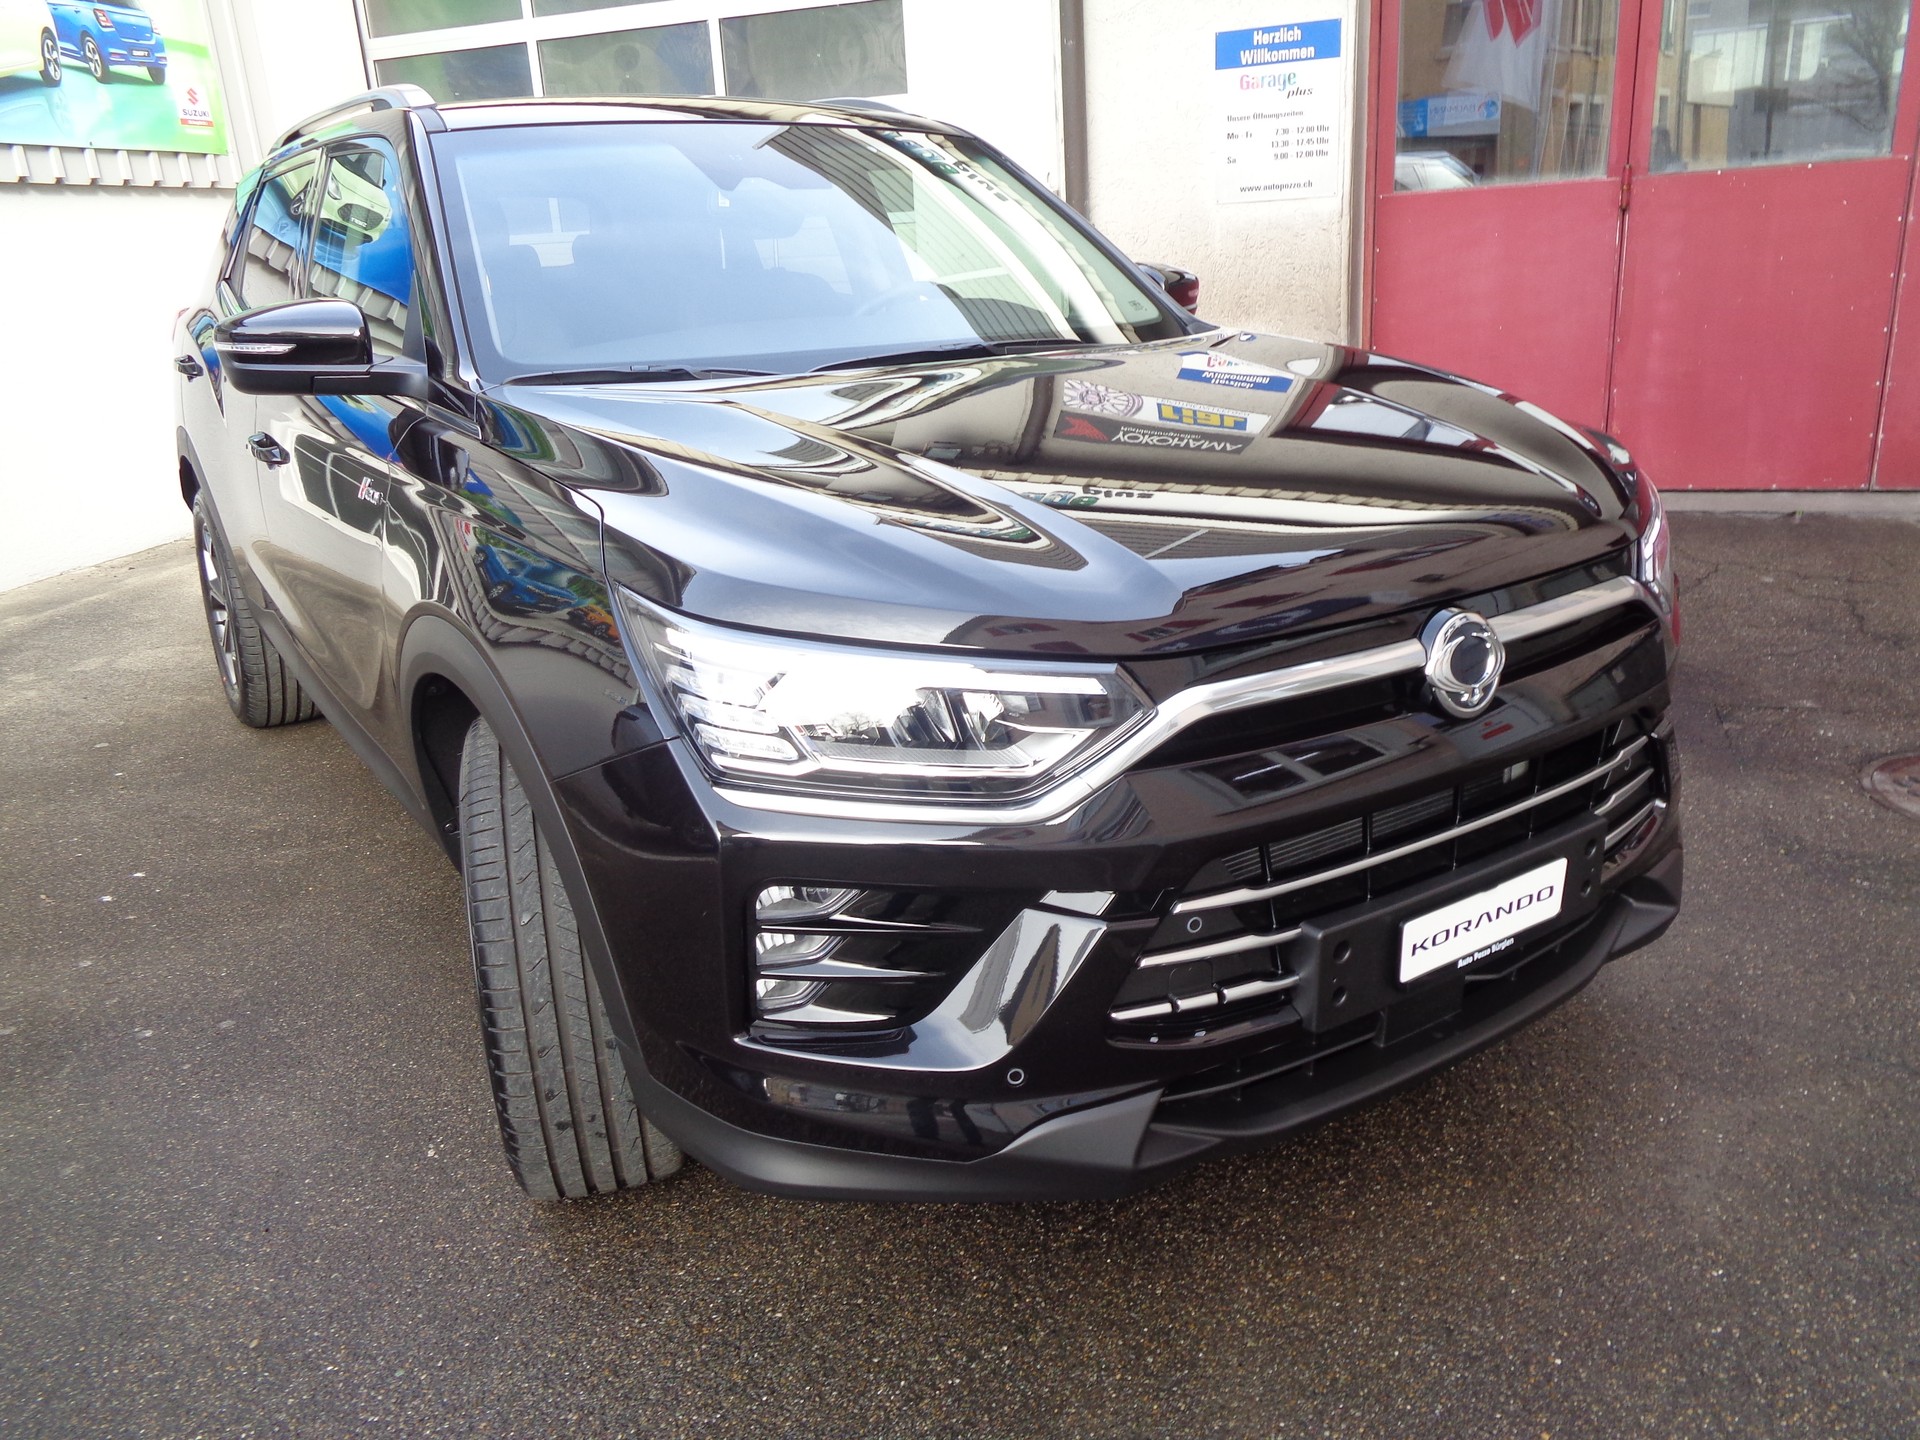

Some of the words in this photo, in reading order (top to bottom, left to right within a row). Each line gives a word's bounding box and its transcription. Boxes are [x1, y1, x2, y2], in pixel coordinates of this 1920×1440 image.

[1253, 26, 1302, 45] Herzlich
[1240, 46, 1315, 65] Willkommen
[1239, 72, 1297, 91] Garage
[1286, 87, 1313, 99] plus
[182, 108, 210, 118] SUZUKI
[1226, 132, 1239, 140] Mo
[1296, 125, 1315, 134] 12.00
[1316, 124, 1330, 132] Uhr
[1316, 136, 1330, 145] Uhr
[1226, 156, 1237, 165] Sa
[1315, 149, 1329, 157] Uhr
[1239, 180, 1313, 193] www.autopozzo.ch
[1411, 885, 1555, 957] KORANDO
[1457, 955, 1473, 969] Auto
